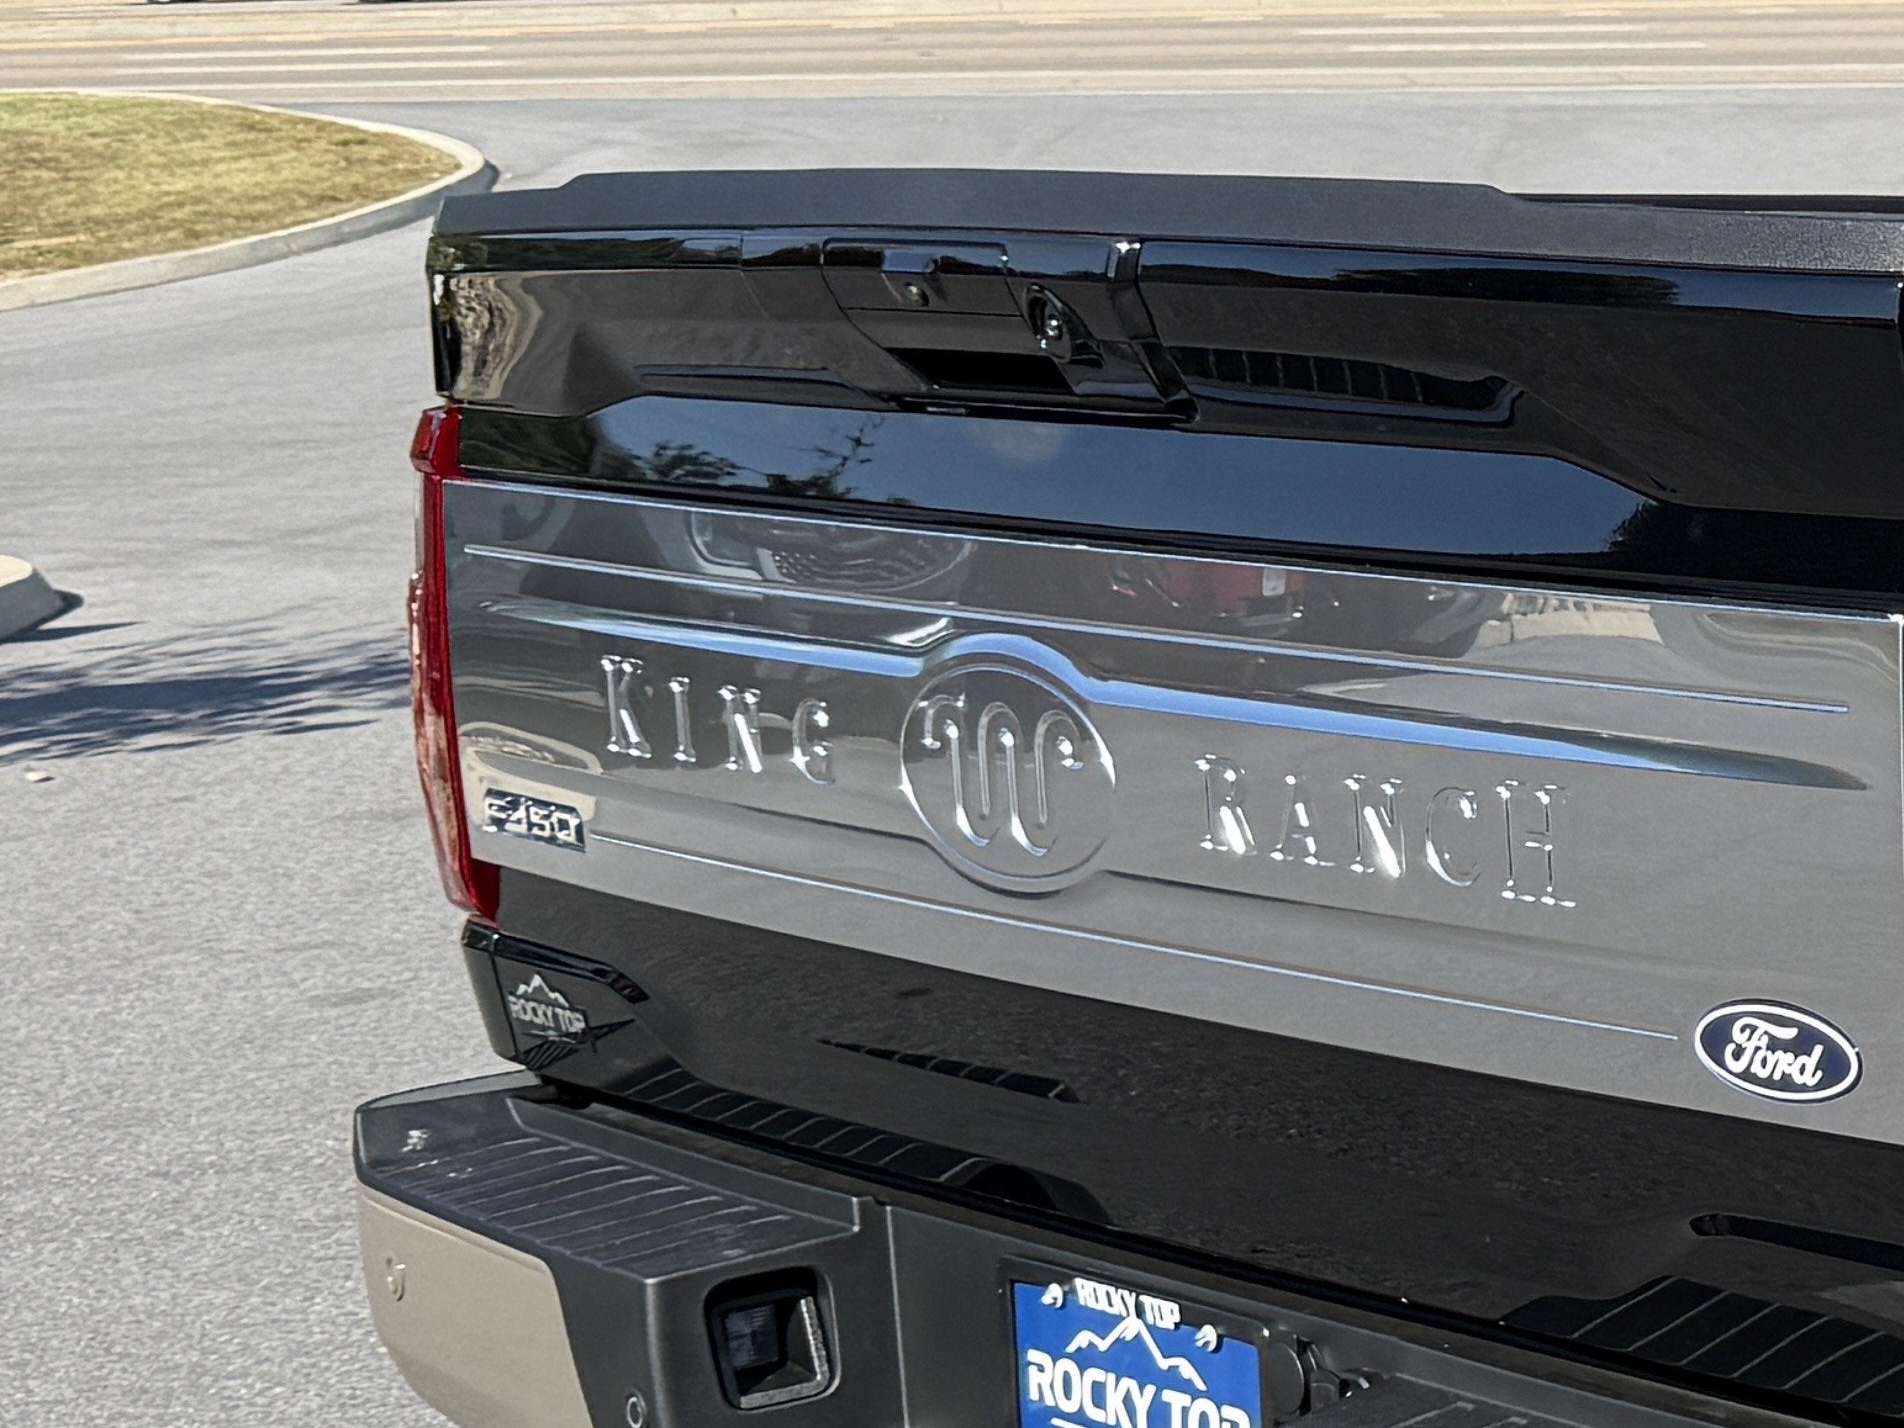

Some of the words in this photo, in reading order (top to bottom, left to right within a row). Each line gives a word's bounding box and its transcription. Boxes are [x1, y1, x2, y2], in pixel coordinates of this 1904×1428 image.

[600, 654, 835, 785] KING
[1196, 753, 1577, 909] RANCH
[1724, 1016, 1825, 1087] Ford
[1073, 1276, 1137, 1319] ROCKY
[1138, 1294, 1182, 1330] TOP
